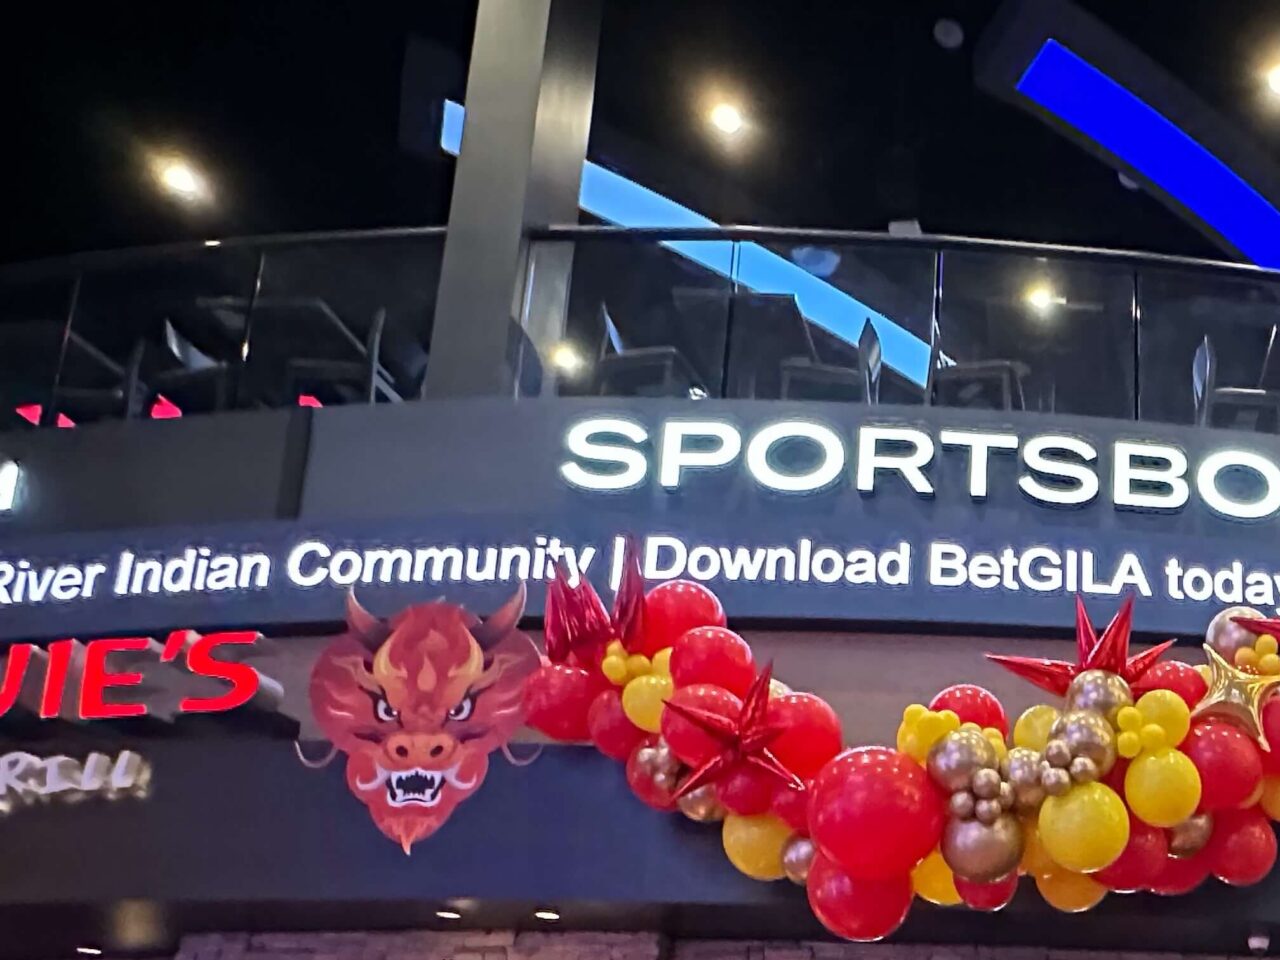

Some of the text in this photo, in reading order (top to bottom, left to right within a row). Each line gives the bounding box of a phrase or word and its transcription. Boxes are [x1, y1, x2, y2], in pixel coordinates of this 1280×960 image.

[114, 548, 271, 595] Indian
[287, 534, 596, 590] Community
[644, 535, 912, 586] Download
[930, 541, 1153, 598] BetGILA
